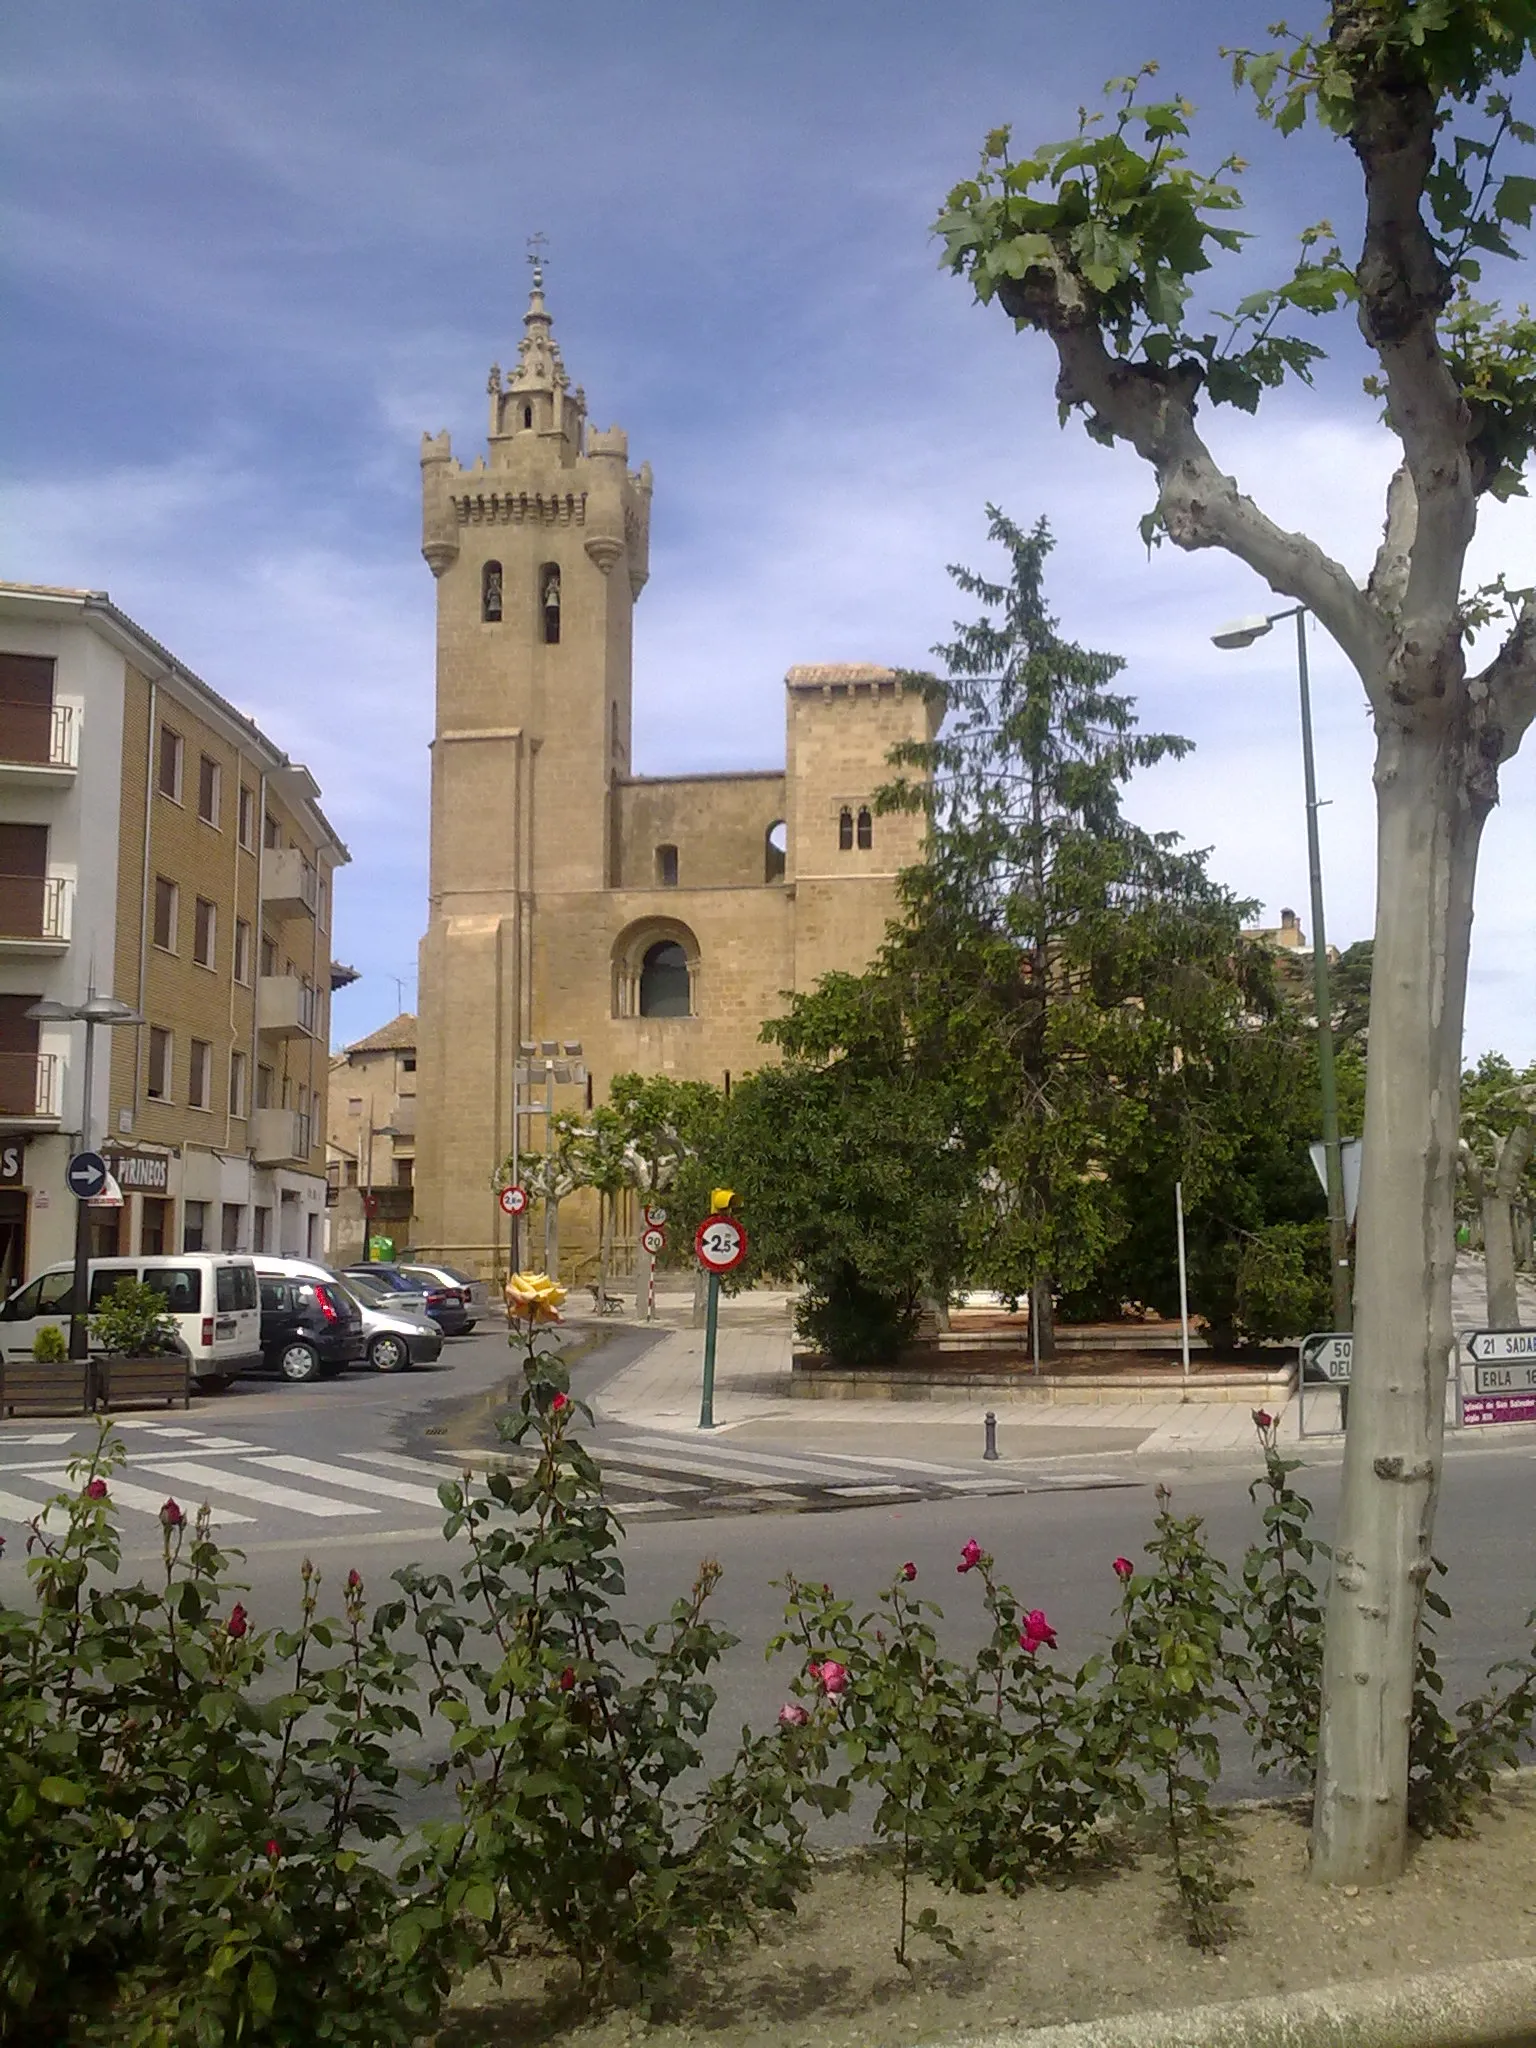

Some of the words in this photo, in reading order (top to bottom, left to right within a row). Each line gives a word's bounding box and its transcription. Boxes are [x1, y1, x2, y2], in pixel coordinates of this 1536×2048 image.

[3, 1148, 18, 1177] S
[117, 1156, 167, 1187] PIRINEOS
[647, 1236, 661, 1247] 20
[1334, 1342, 1350, 1357] 50
[1483, 1338, 1495, 1354] 21
[1482, 1371, 1512, 1387] ERLA
